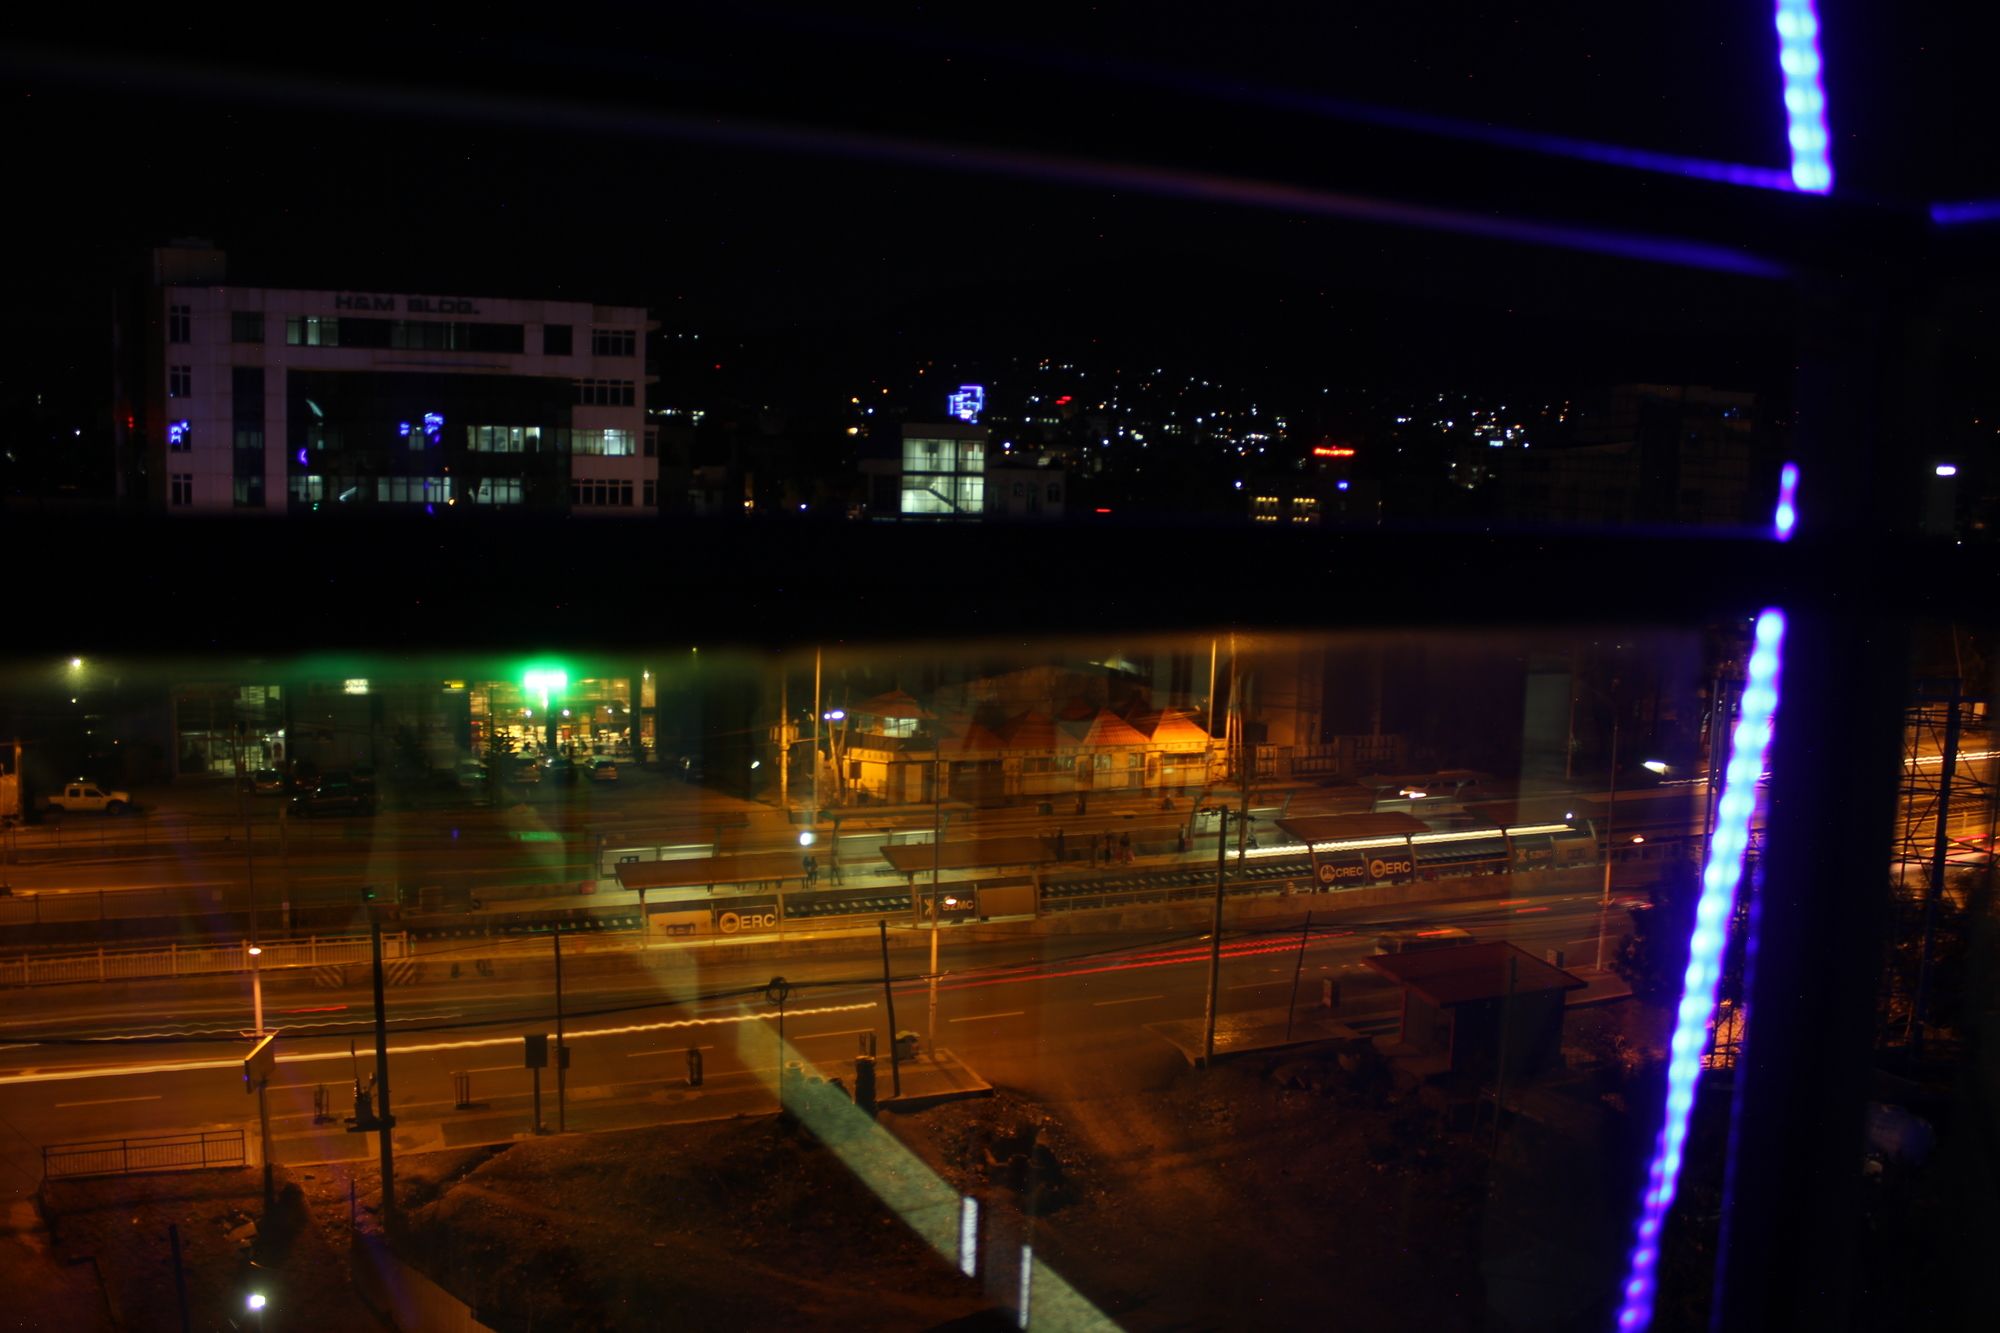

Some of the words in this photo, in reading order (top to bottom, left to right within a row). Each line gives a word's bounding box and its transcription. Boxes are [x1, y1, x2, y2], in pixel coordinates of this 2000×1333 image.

[335, 295, 395, 312] H&M
[1335, 866, 1364, 878] CREC
[1385, 861, 1412, 874] ERC
[740, 913, 776, 929] ERC
